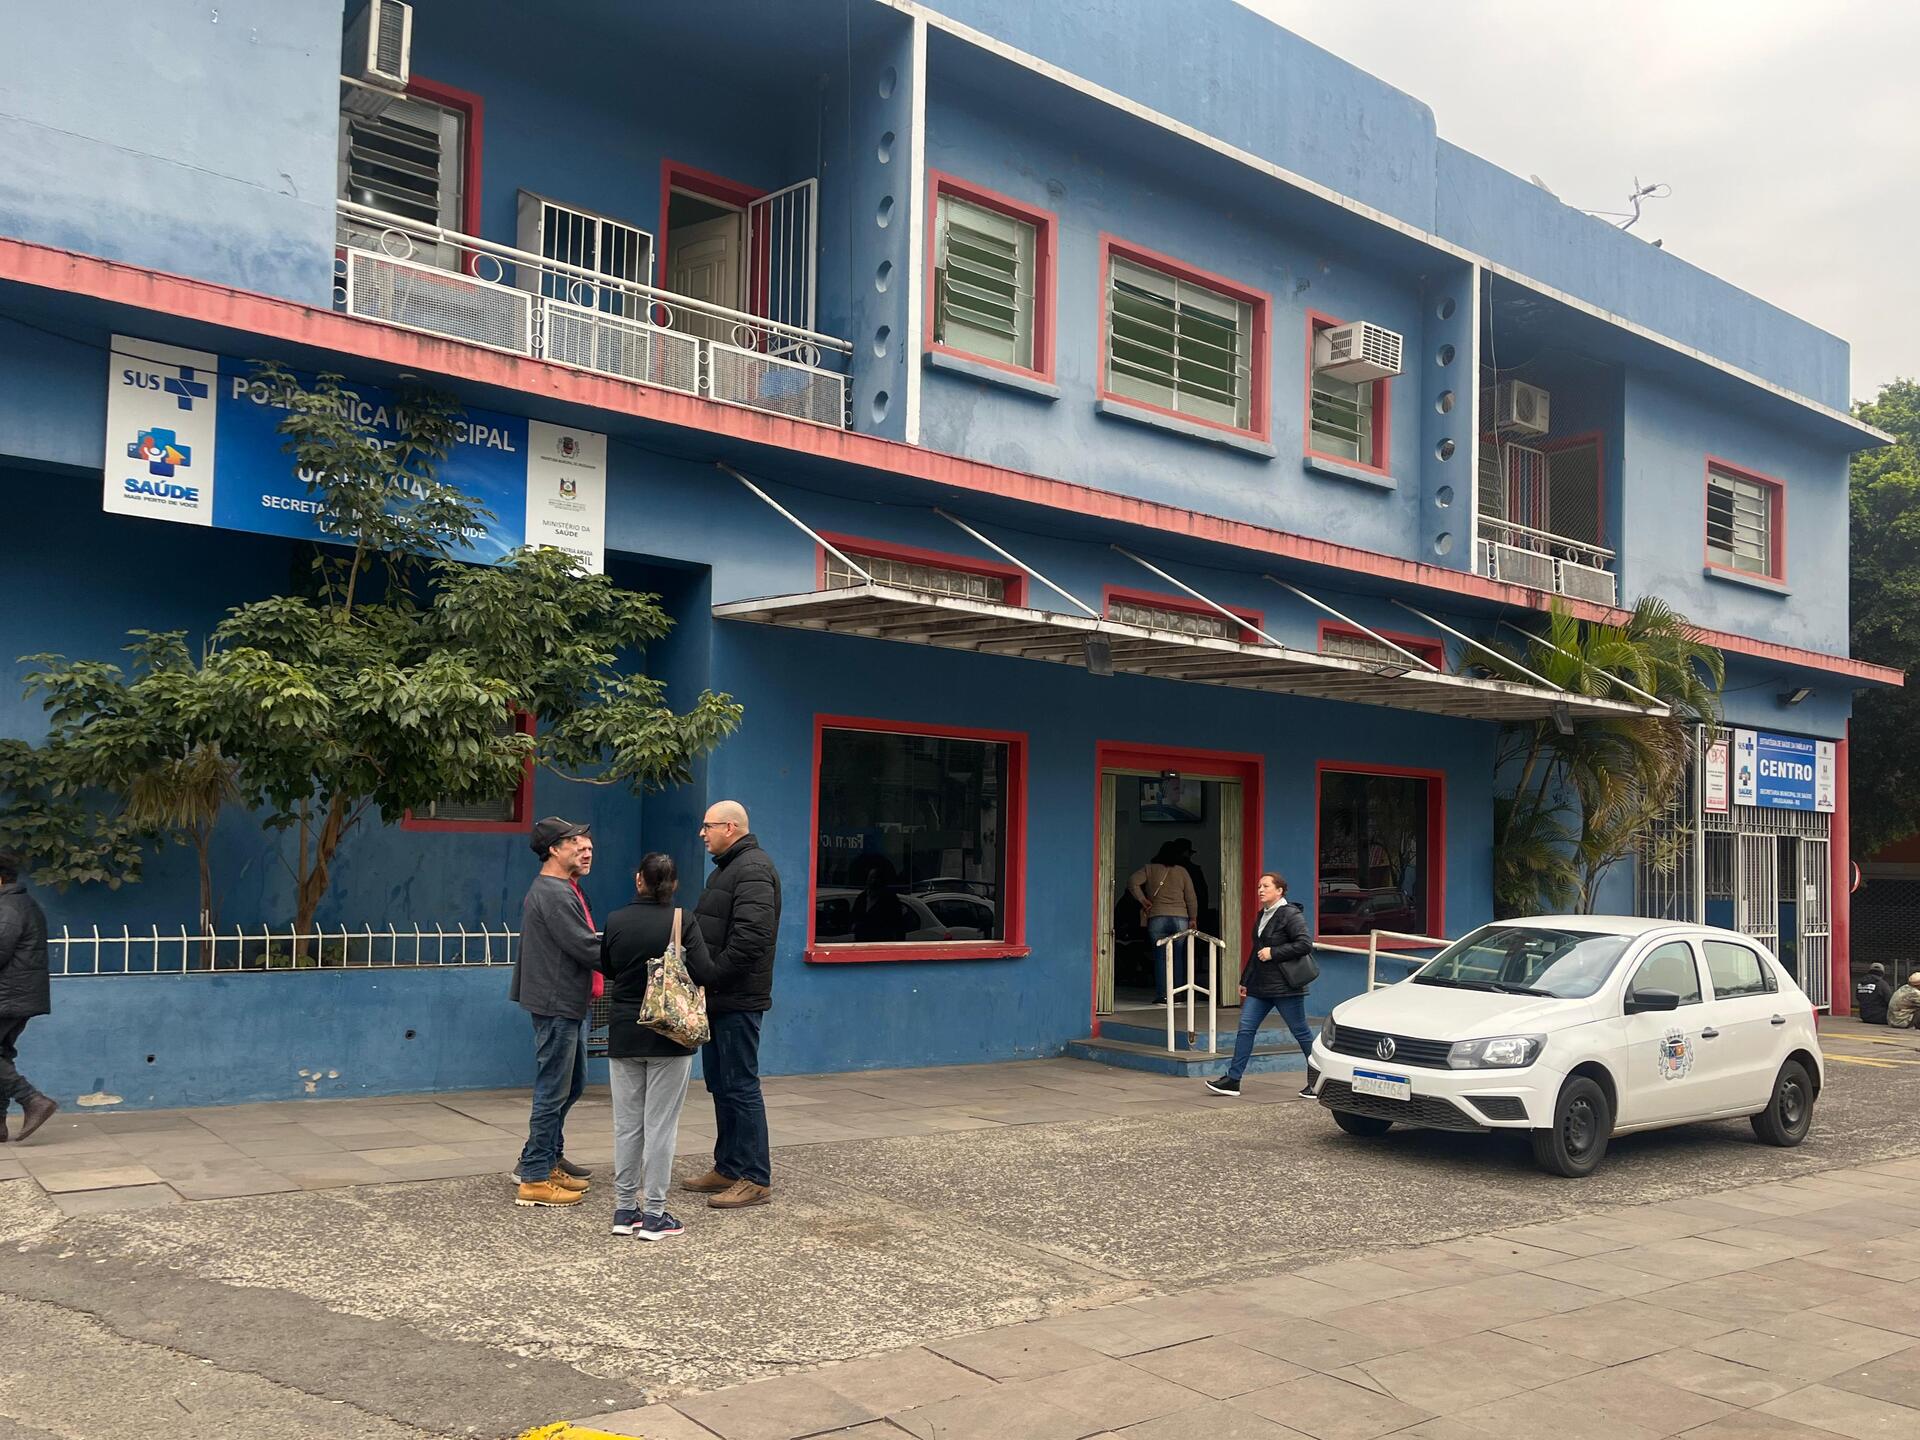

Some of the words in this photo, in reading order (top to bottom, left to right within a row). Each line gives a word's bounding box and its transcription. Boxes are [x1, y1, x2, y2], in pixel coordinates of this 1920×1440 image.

[123, 369, 160, 390] SUS
[124, 478, 199, 502] SAÚDE
[581, 525, 591, 533] DA
[1760, 758, 1812, 782] CENTRO
